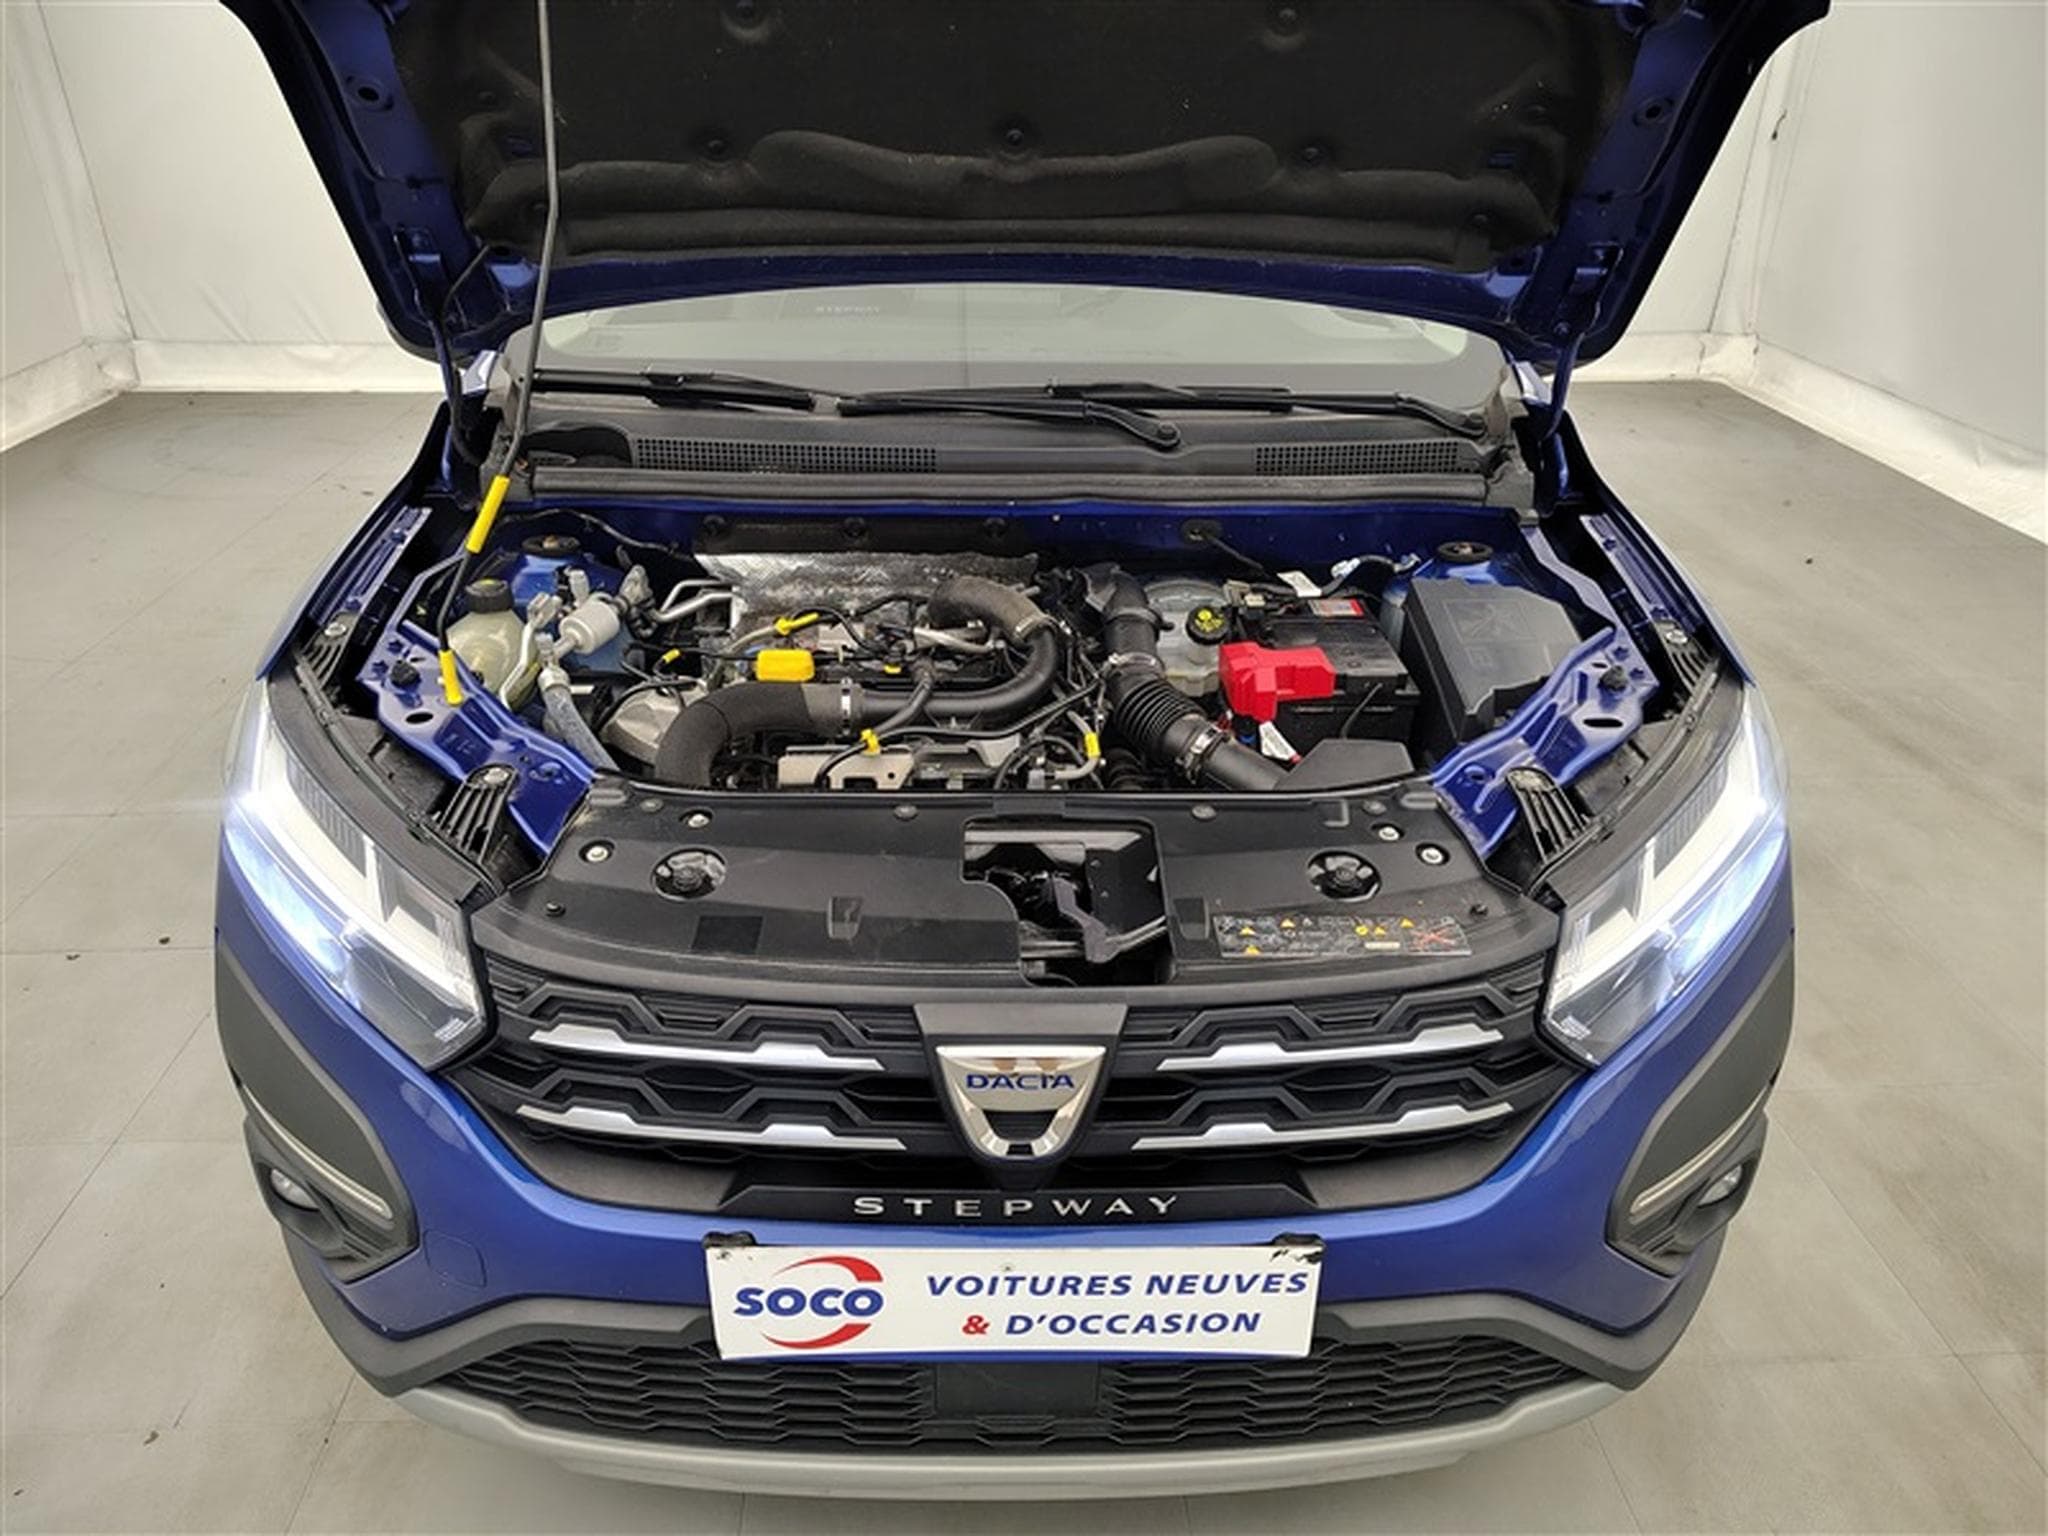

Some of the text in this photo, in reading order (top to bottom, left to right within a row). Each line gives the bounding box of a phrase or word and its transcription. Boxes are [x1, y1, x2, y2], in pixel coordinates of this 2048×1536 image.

[966, 1073, 1074, 1090] DACIA
[853, 1195, 1179, 1219] STEPWAY
[928, 1272, 1308, 1297] VOITURES NEUVES
[734, 1287, 885, 1318] SOCO
[962, 1312, 1261, 1335] & D'OCCASION
